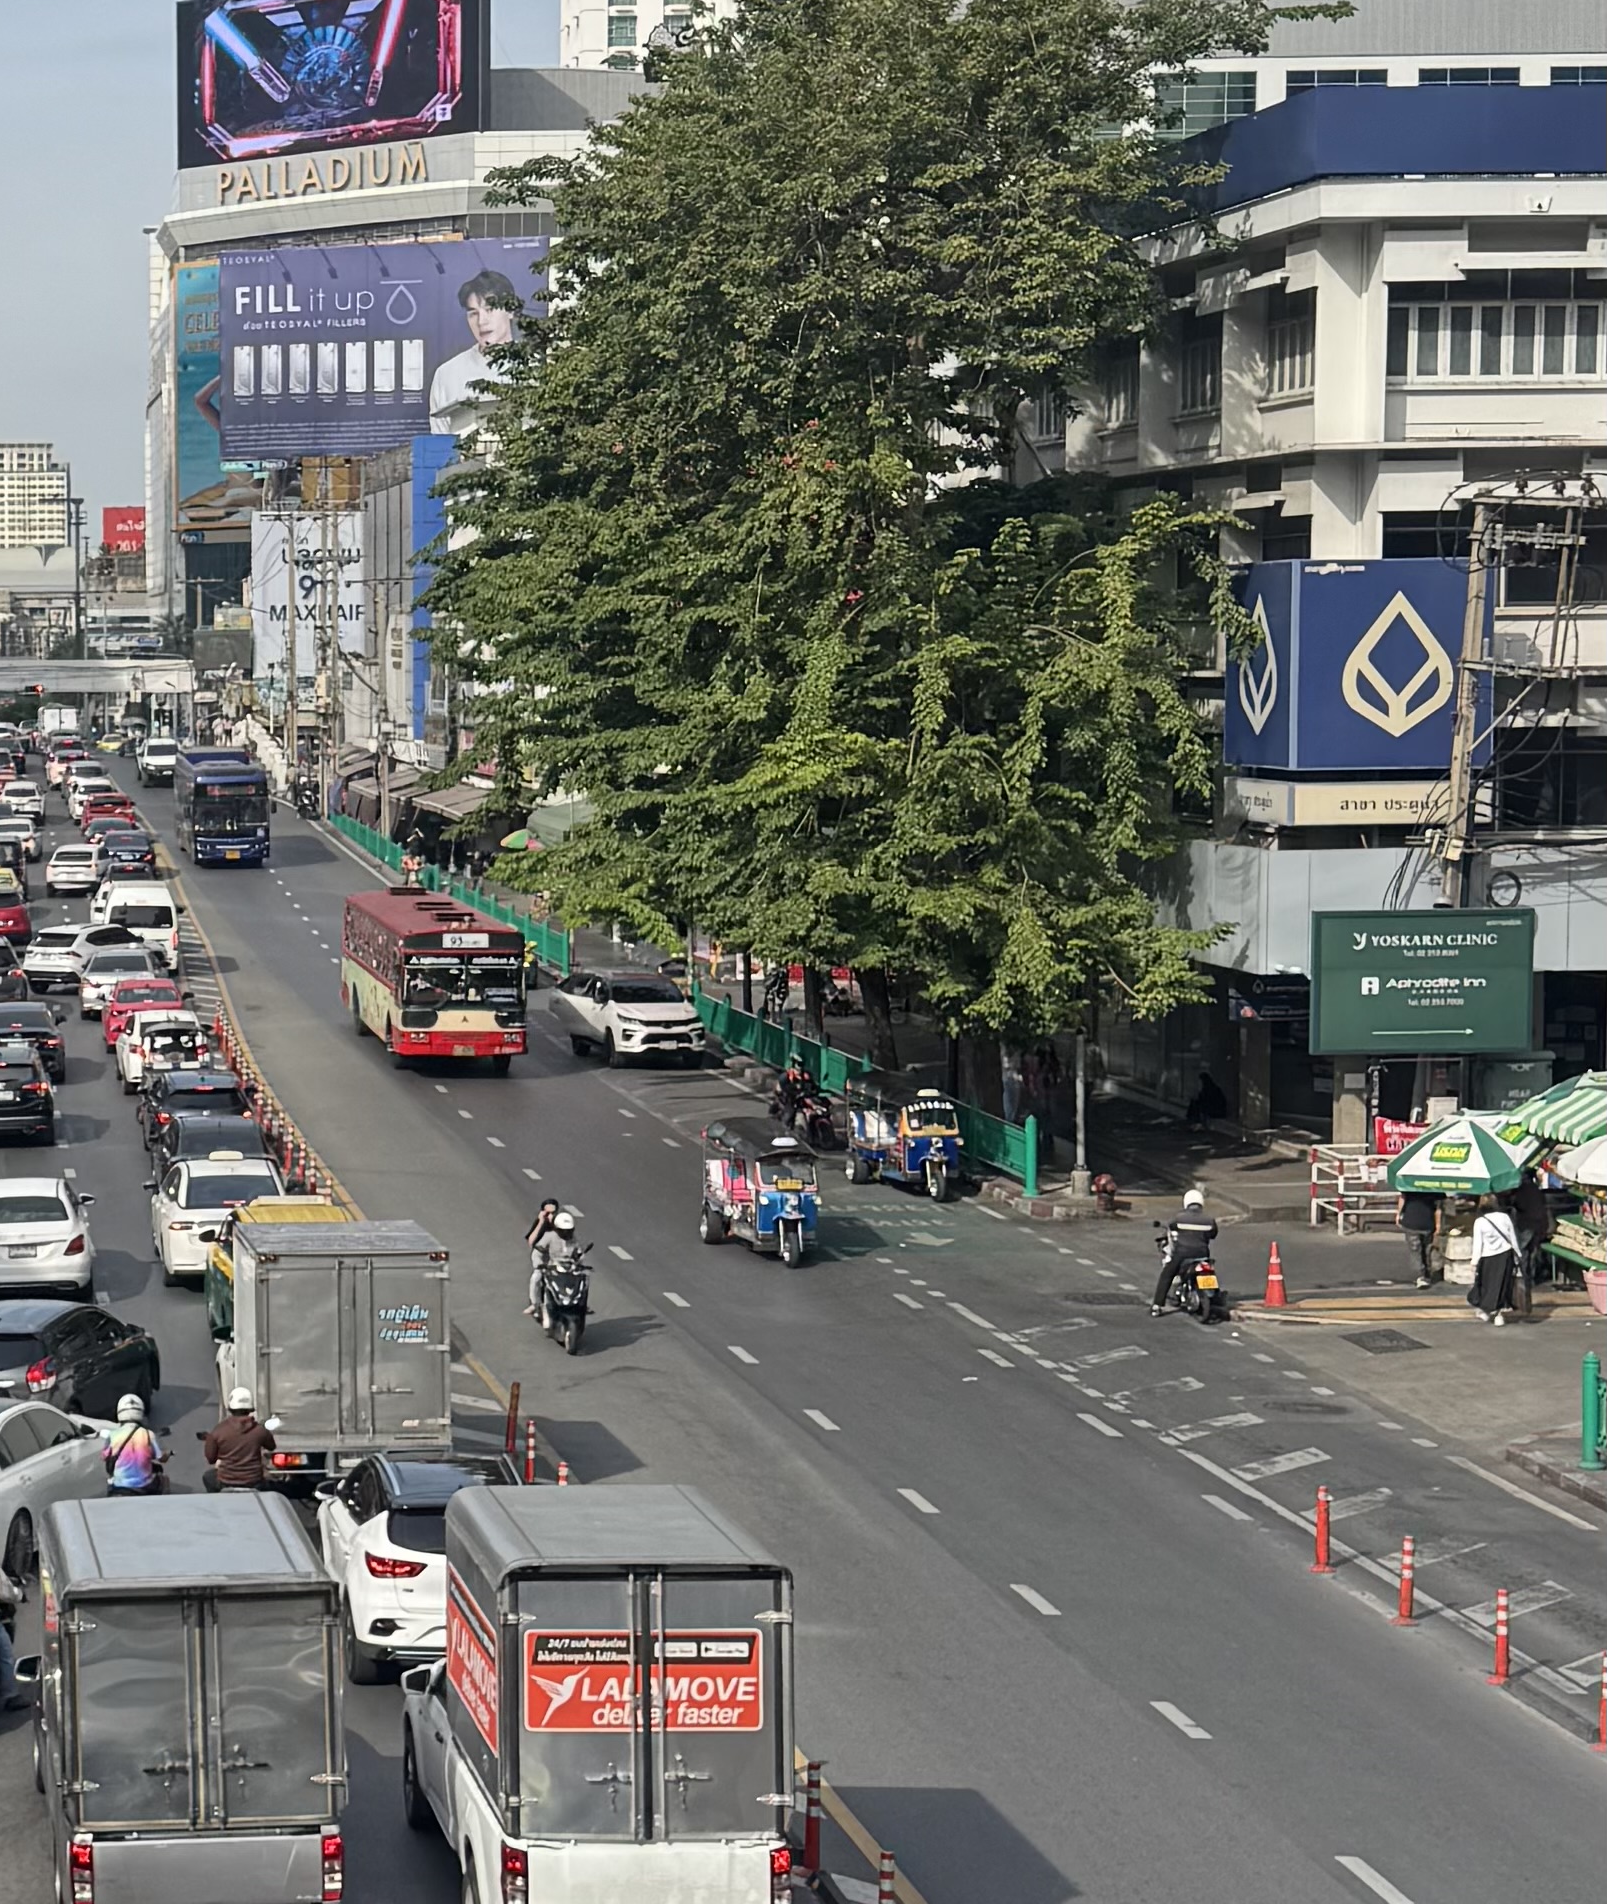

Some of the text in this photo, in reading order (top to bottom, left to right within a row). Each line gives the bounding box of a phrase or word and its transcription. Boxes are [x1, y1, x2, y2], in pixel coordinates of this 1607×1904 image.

[217, 143, 427, 203] PALLADIUM
[235, 283, 301, 315] FILL
[309, 287, 326, 312] it
[335, 290, 374, 316] up
[1371, 934, 1444, 946] YOSKARN
[1446, 933, 1498, 946] CLINIC
[1386, 978, 1460, 989] Aphrodite
[580, 1676, 758, 1702] LALMOVE
[677, 1701, 744, 1725] faster
